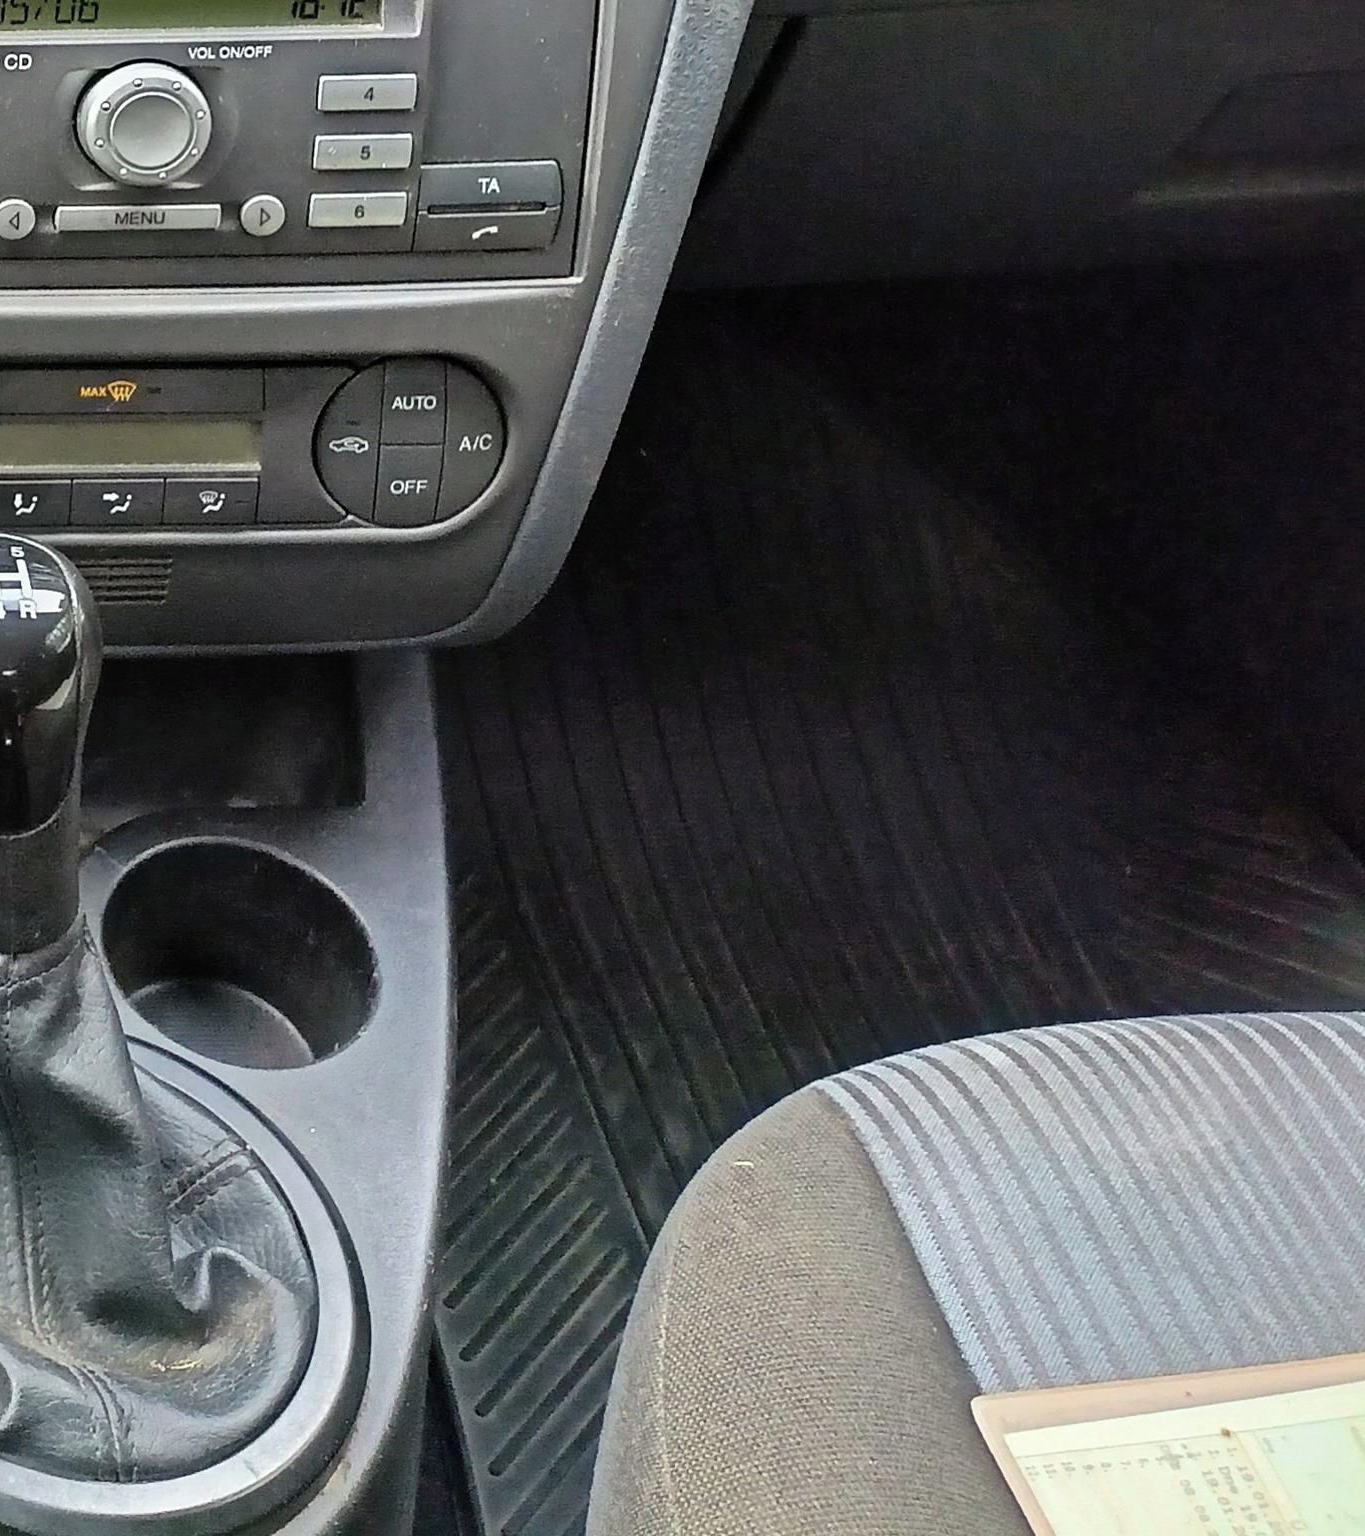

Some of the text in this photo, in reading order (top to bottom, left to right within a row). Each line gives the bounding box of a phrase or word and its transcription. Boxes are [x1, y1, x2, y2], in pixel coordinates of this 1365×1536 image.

[187, 44, 273, 61] VOL ON/OFF
[3, 53, 33, 71] CD
[363, 86, 375, 102] 4
[359, 145, 372, 161] 5
[478, 176, 501, 195] TA
[114, 210, 167, 227] MENU
[354, 203, 365, 220] 6
[79, 386, 107, 398] MAX
[391, 395, 437, 410] AUTO
[459, 433, 493, 452] A/C
[389, 479, 429, 495] OFF
[10, 546, 25, 558] 5
[19, 598, 38, 619] R
